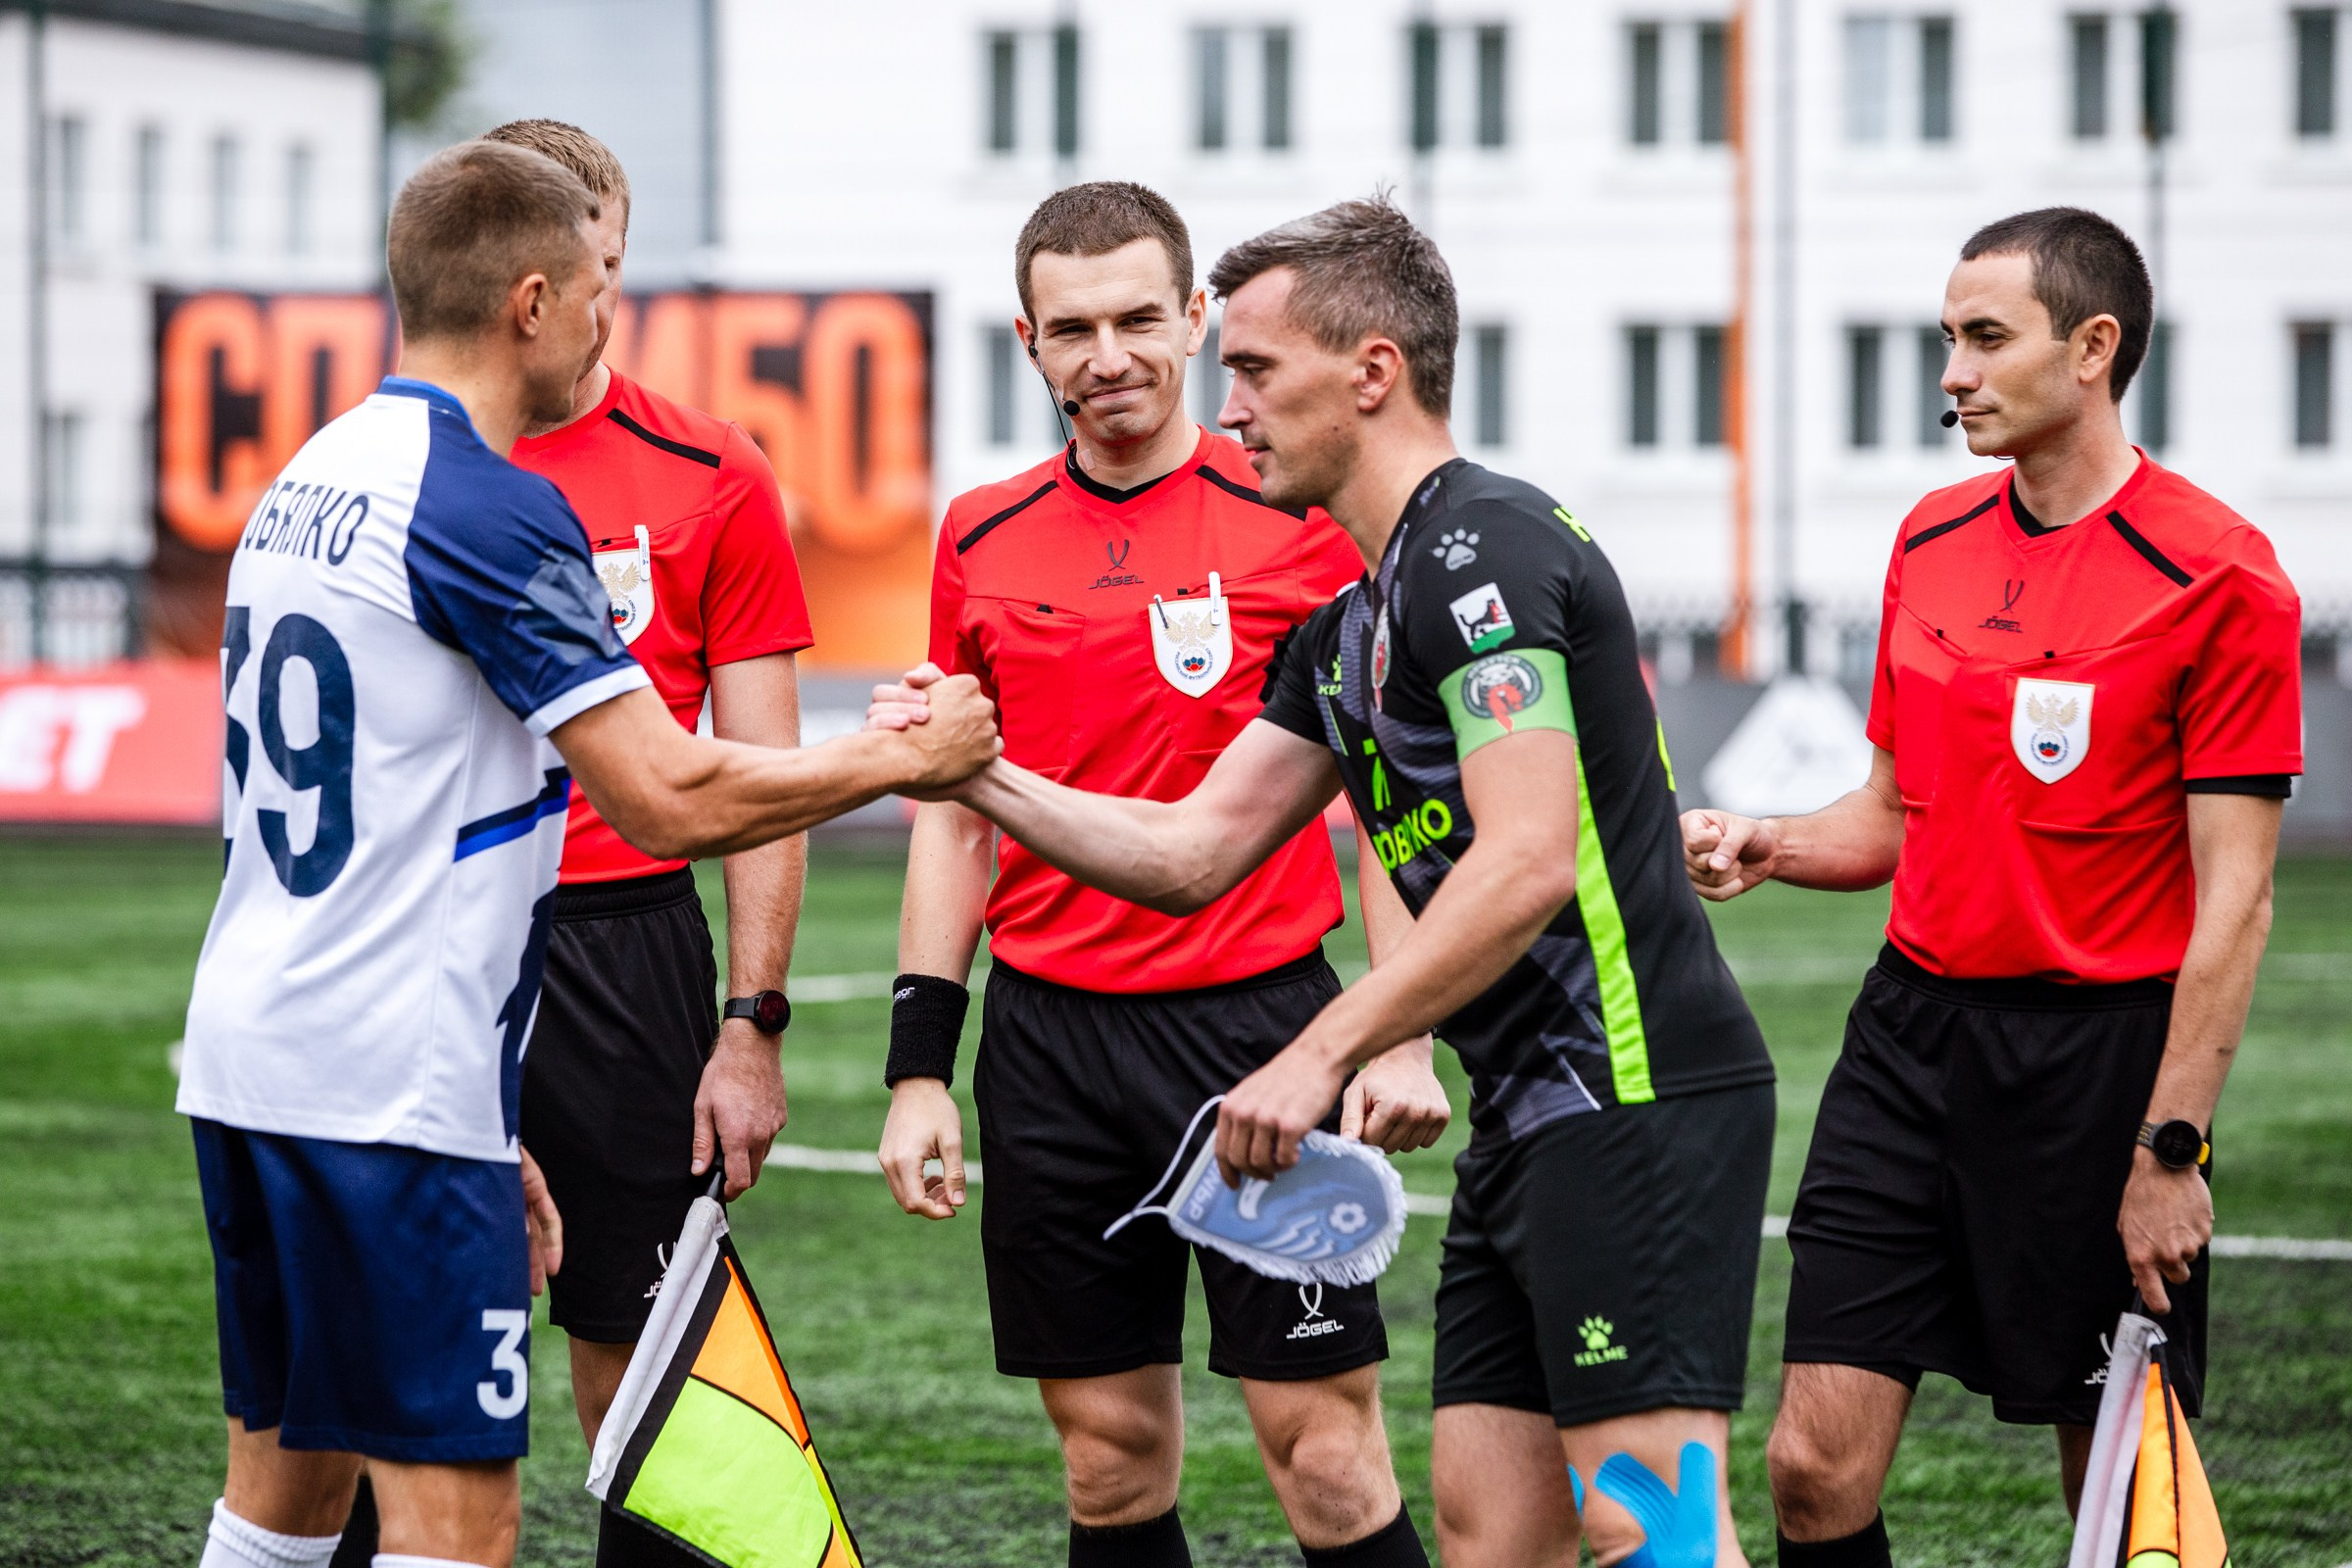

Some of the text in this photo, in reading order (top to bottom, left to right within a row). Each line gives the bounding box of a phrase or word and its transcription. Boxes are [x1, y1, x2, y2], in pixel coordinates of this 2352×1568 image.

[1088, 574, 1146, 590] JÖGEL
[1977, 614, 2024, 633] JÖGEL
[1286, 1319, 1345, 1340] JÖGEL
[476, 1308, 532, 1420] 3
[1573, 1345, 1629, 1368] KELME
